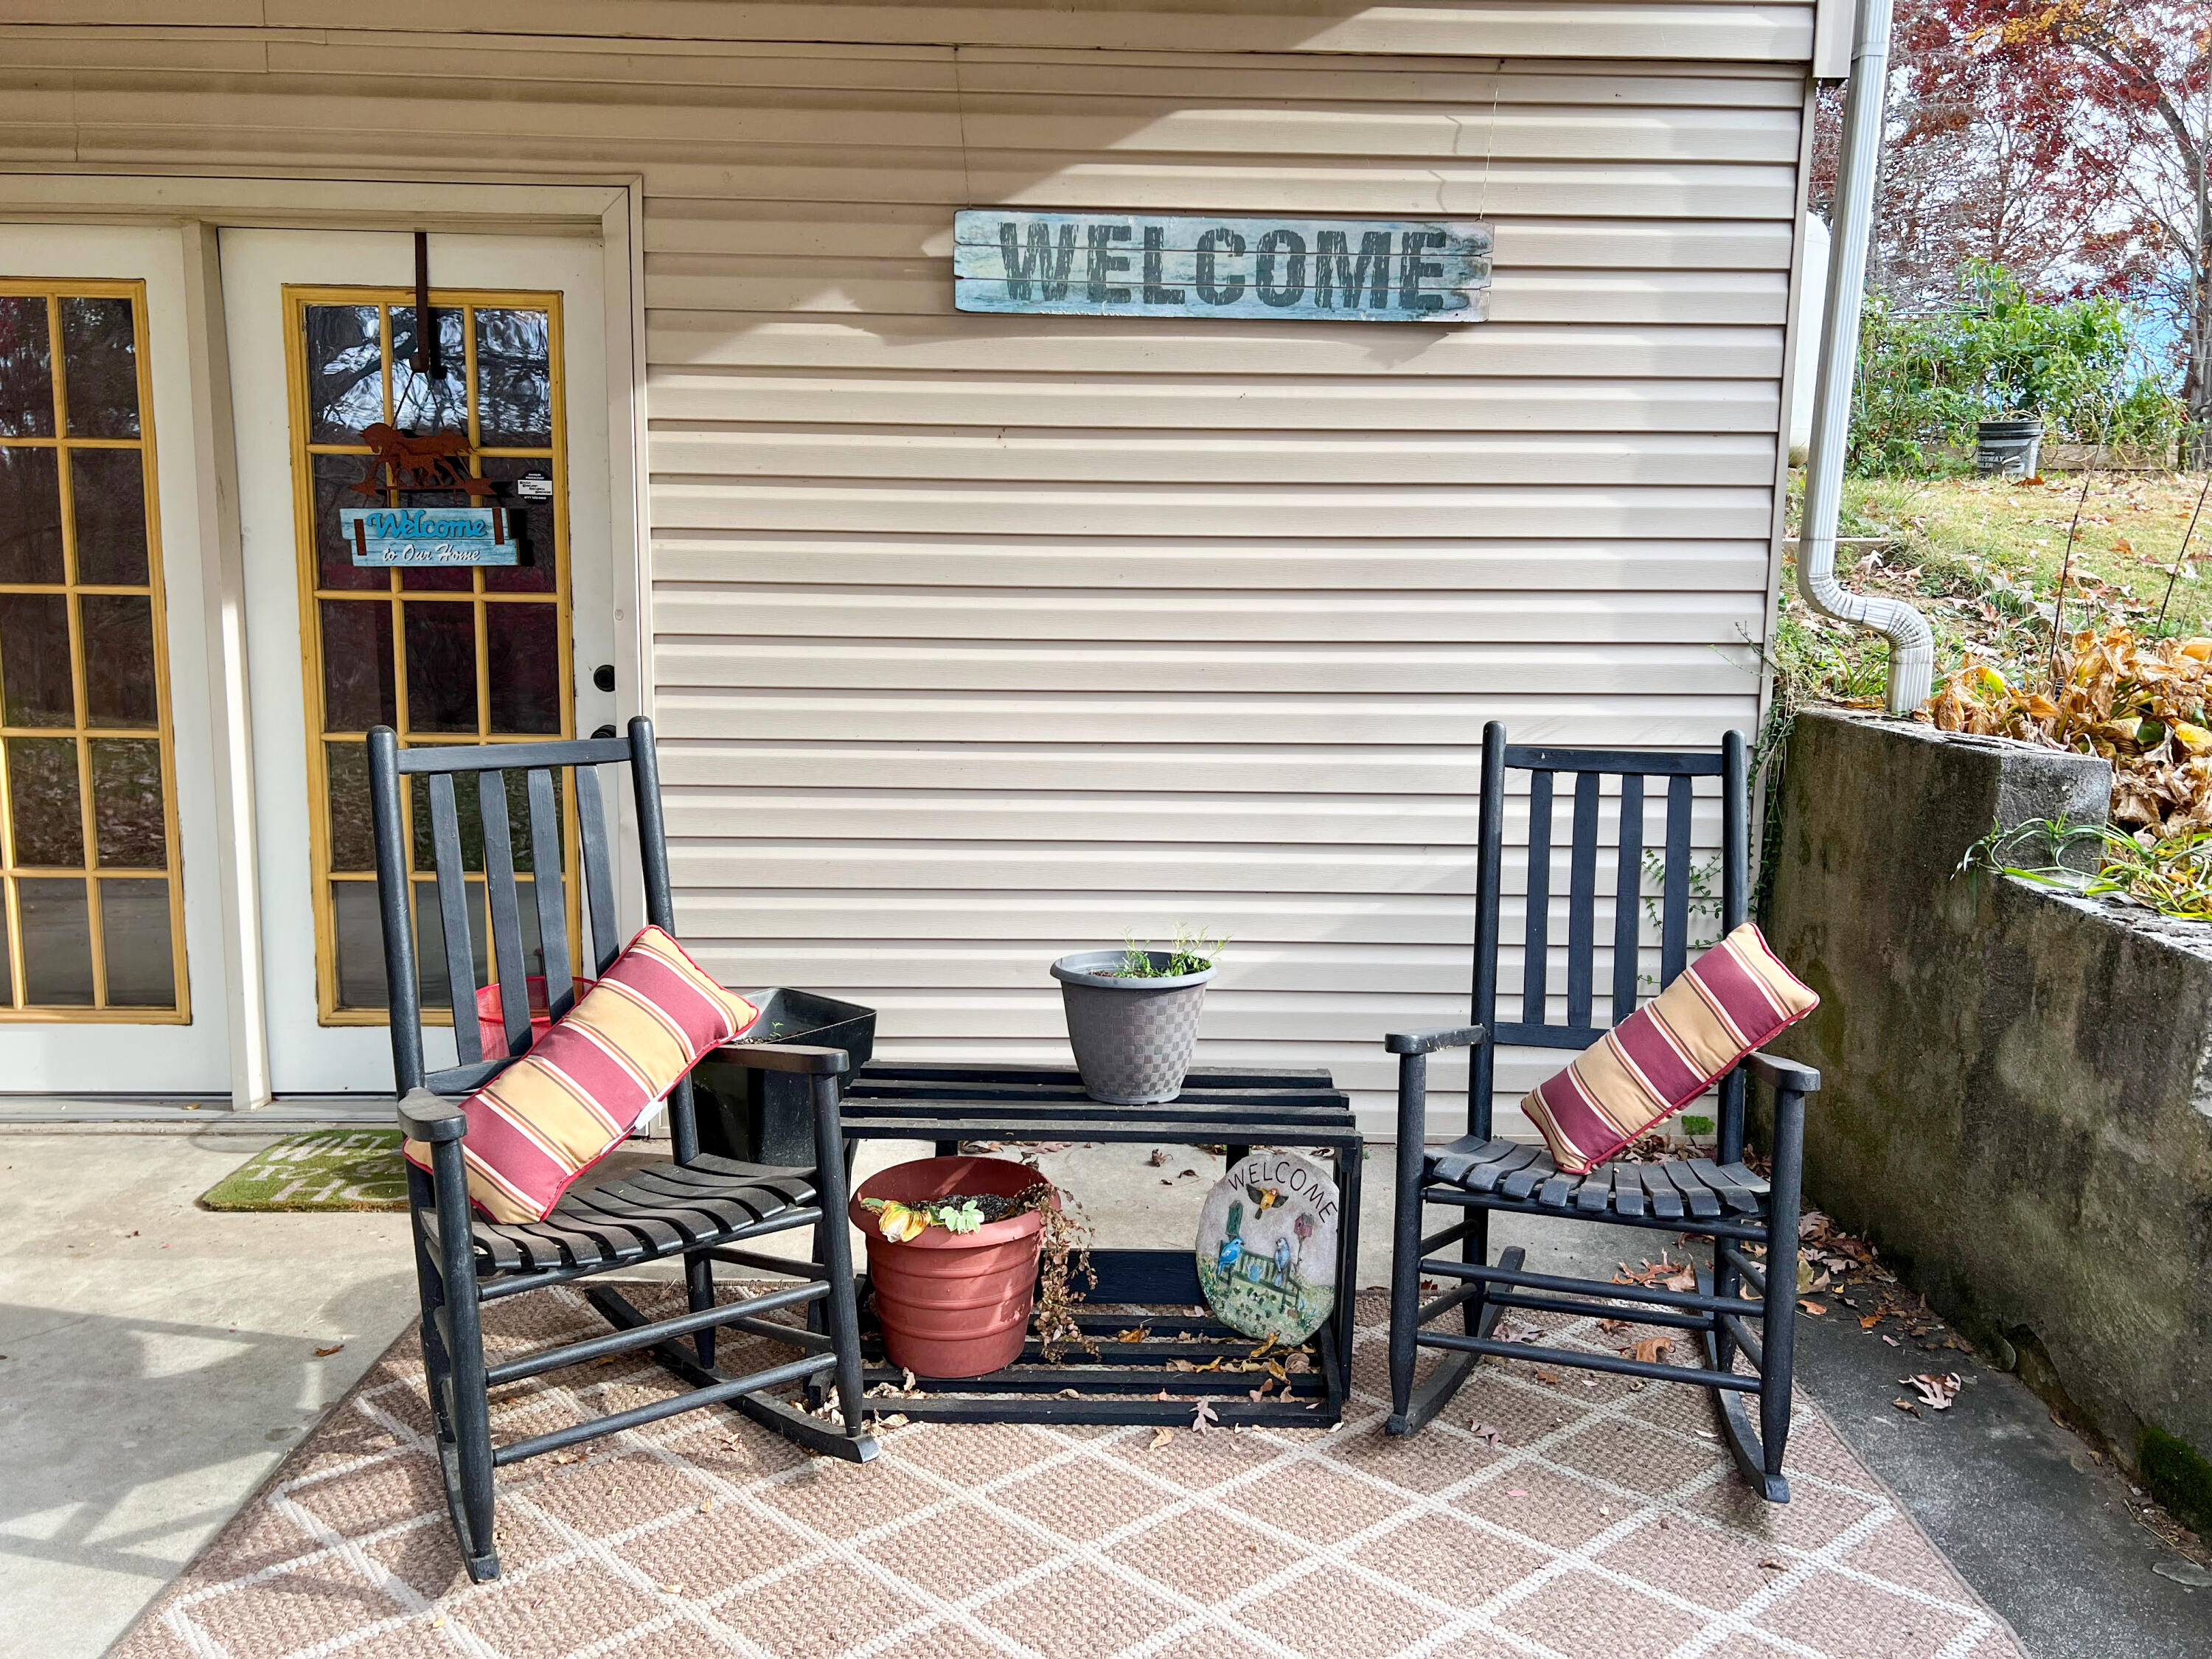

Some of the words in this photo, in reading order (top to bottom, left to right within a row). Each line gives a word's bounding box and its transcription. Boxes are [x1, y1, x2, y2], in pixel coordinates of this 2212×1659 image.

[999, 221, 1447, 309] WELCOME
[366, 509, 487, 538] Welcome
[383, 548, 397, 561] to
[402, 543, 432, 561] Our
[435, 543, 481, 561] Home
[1228, 1161, 1338, 1223] WELCOME
